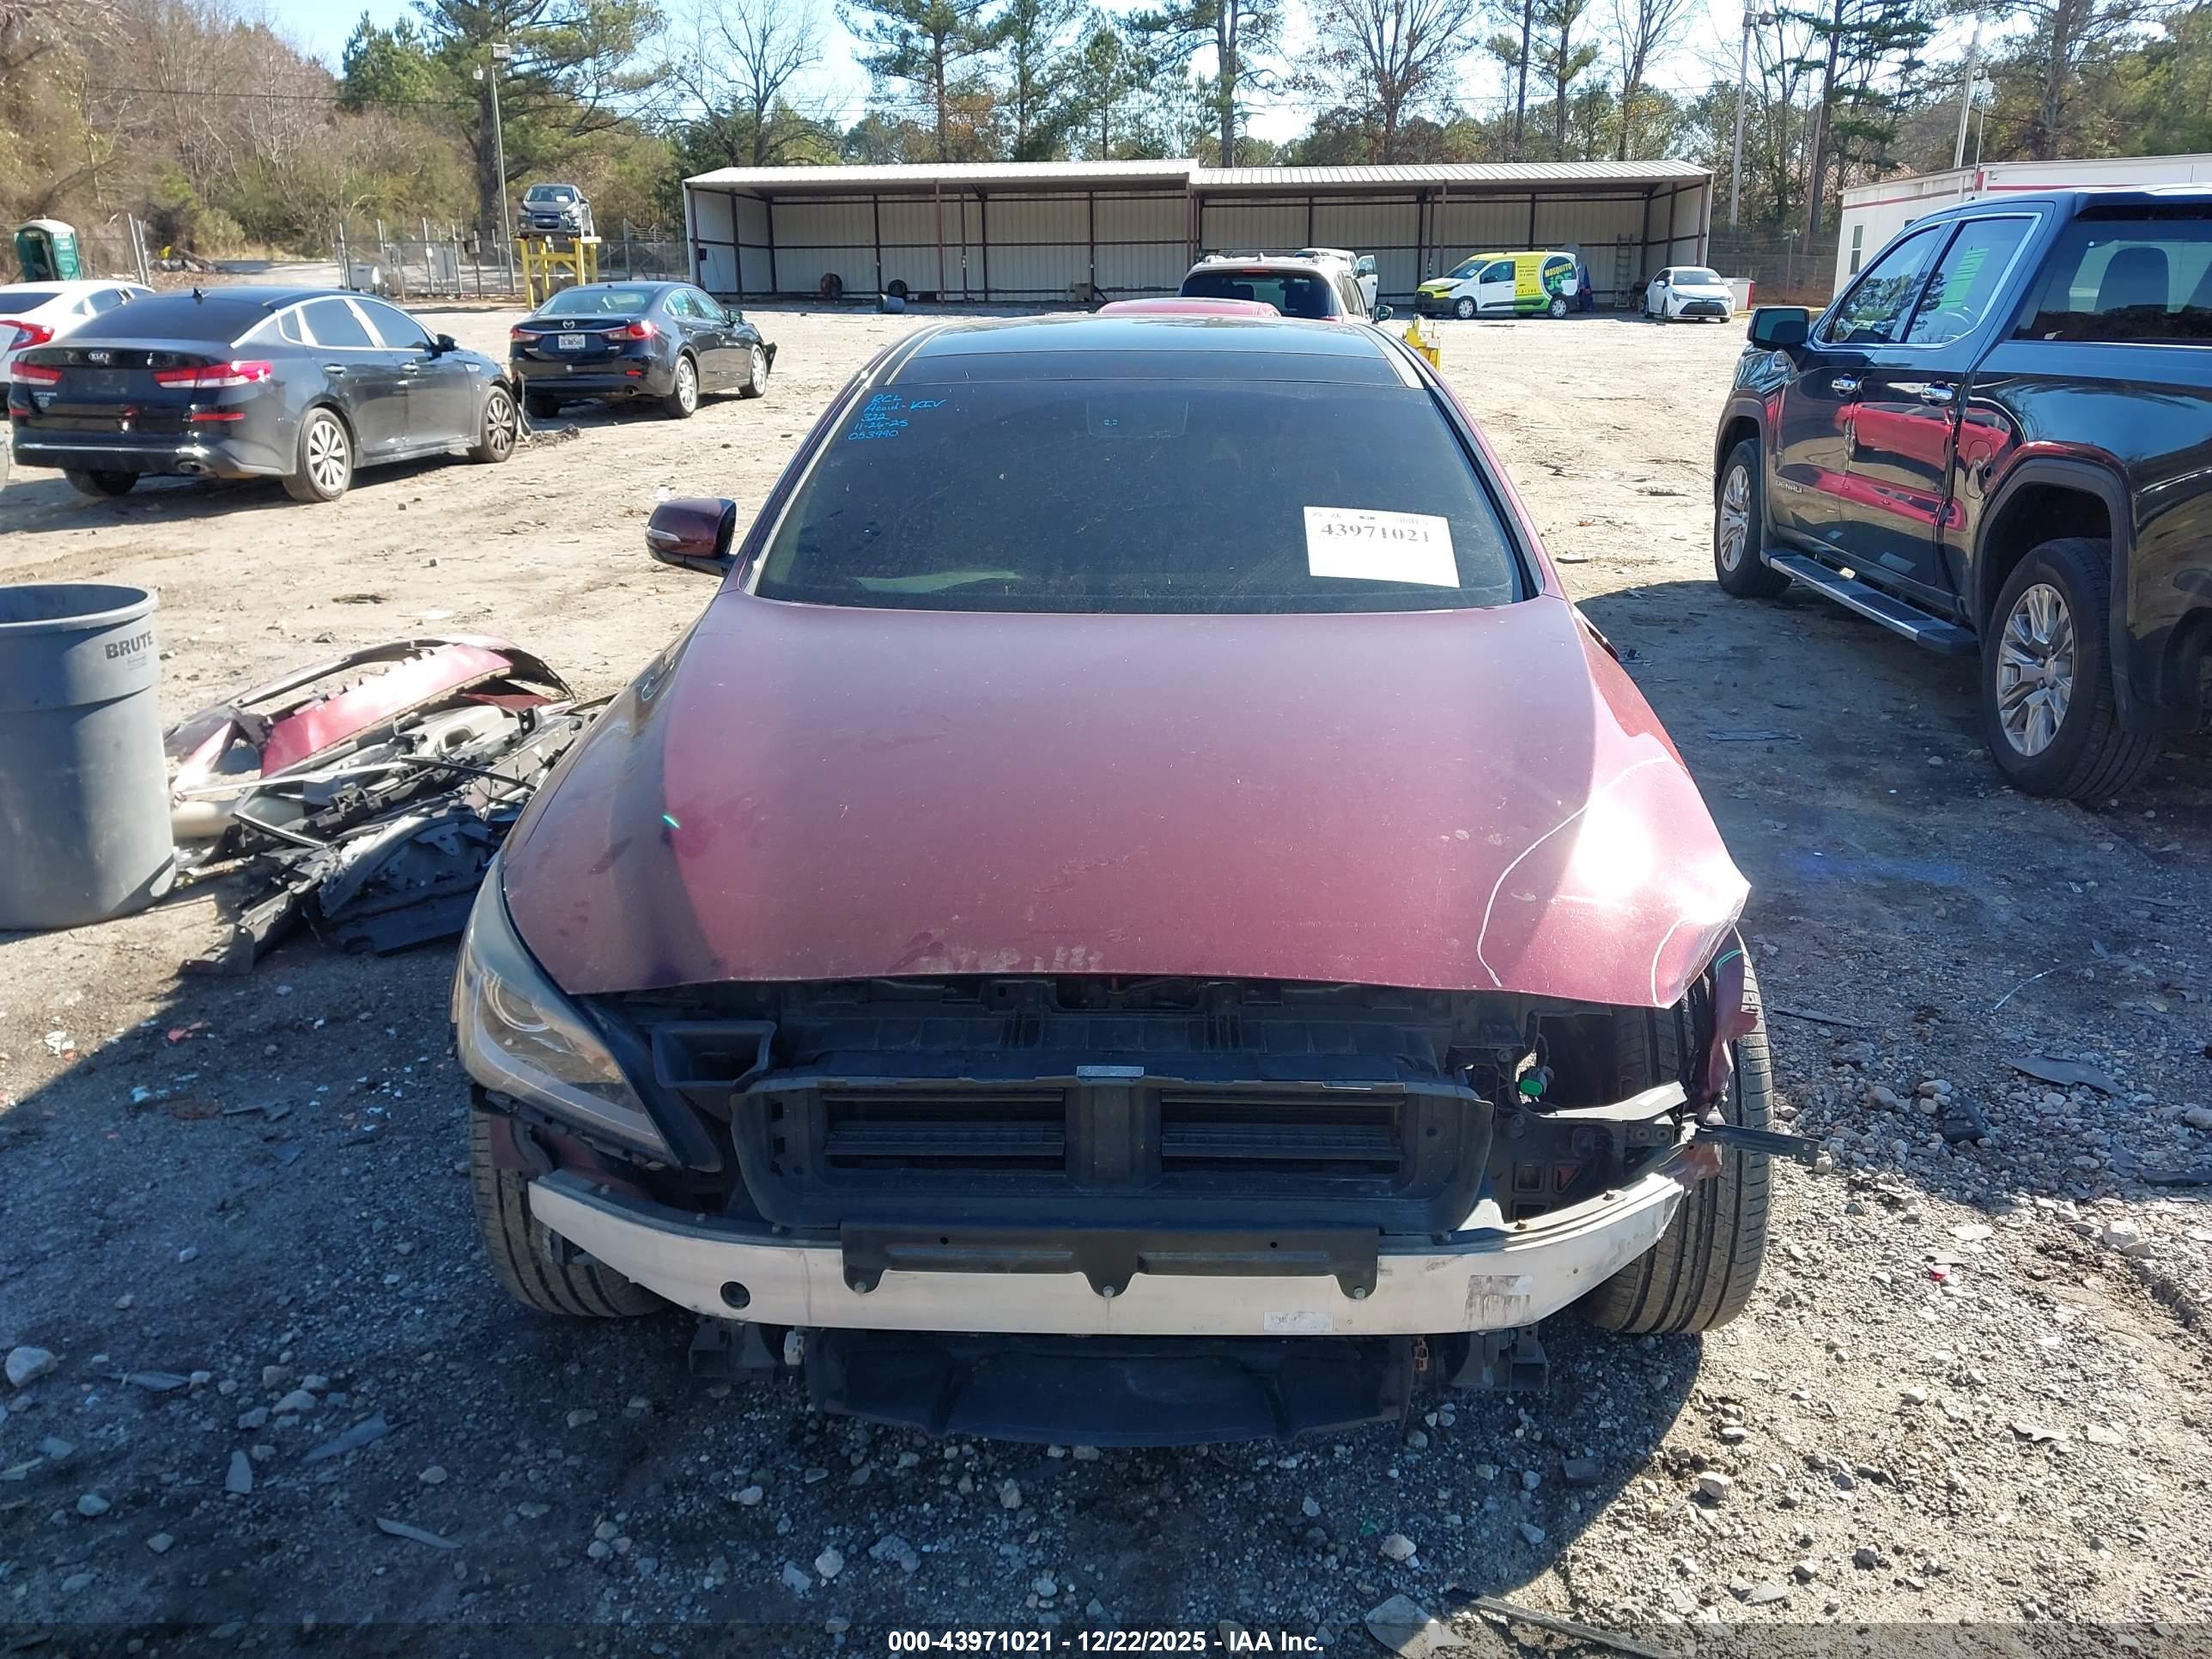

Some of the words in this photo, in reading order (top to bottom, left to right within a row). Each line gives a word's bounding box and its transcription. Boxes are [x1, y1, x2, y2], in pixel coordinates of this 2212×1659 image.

[1545, 263, 1572, 278] MOSQUITO
[1775, 480, 1804, 495] DENALI
[1320, 523, 1430, 543] 43971021
[104, 630, 154, 660] BRUTE
